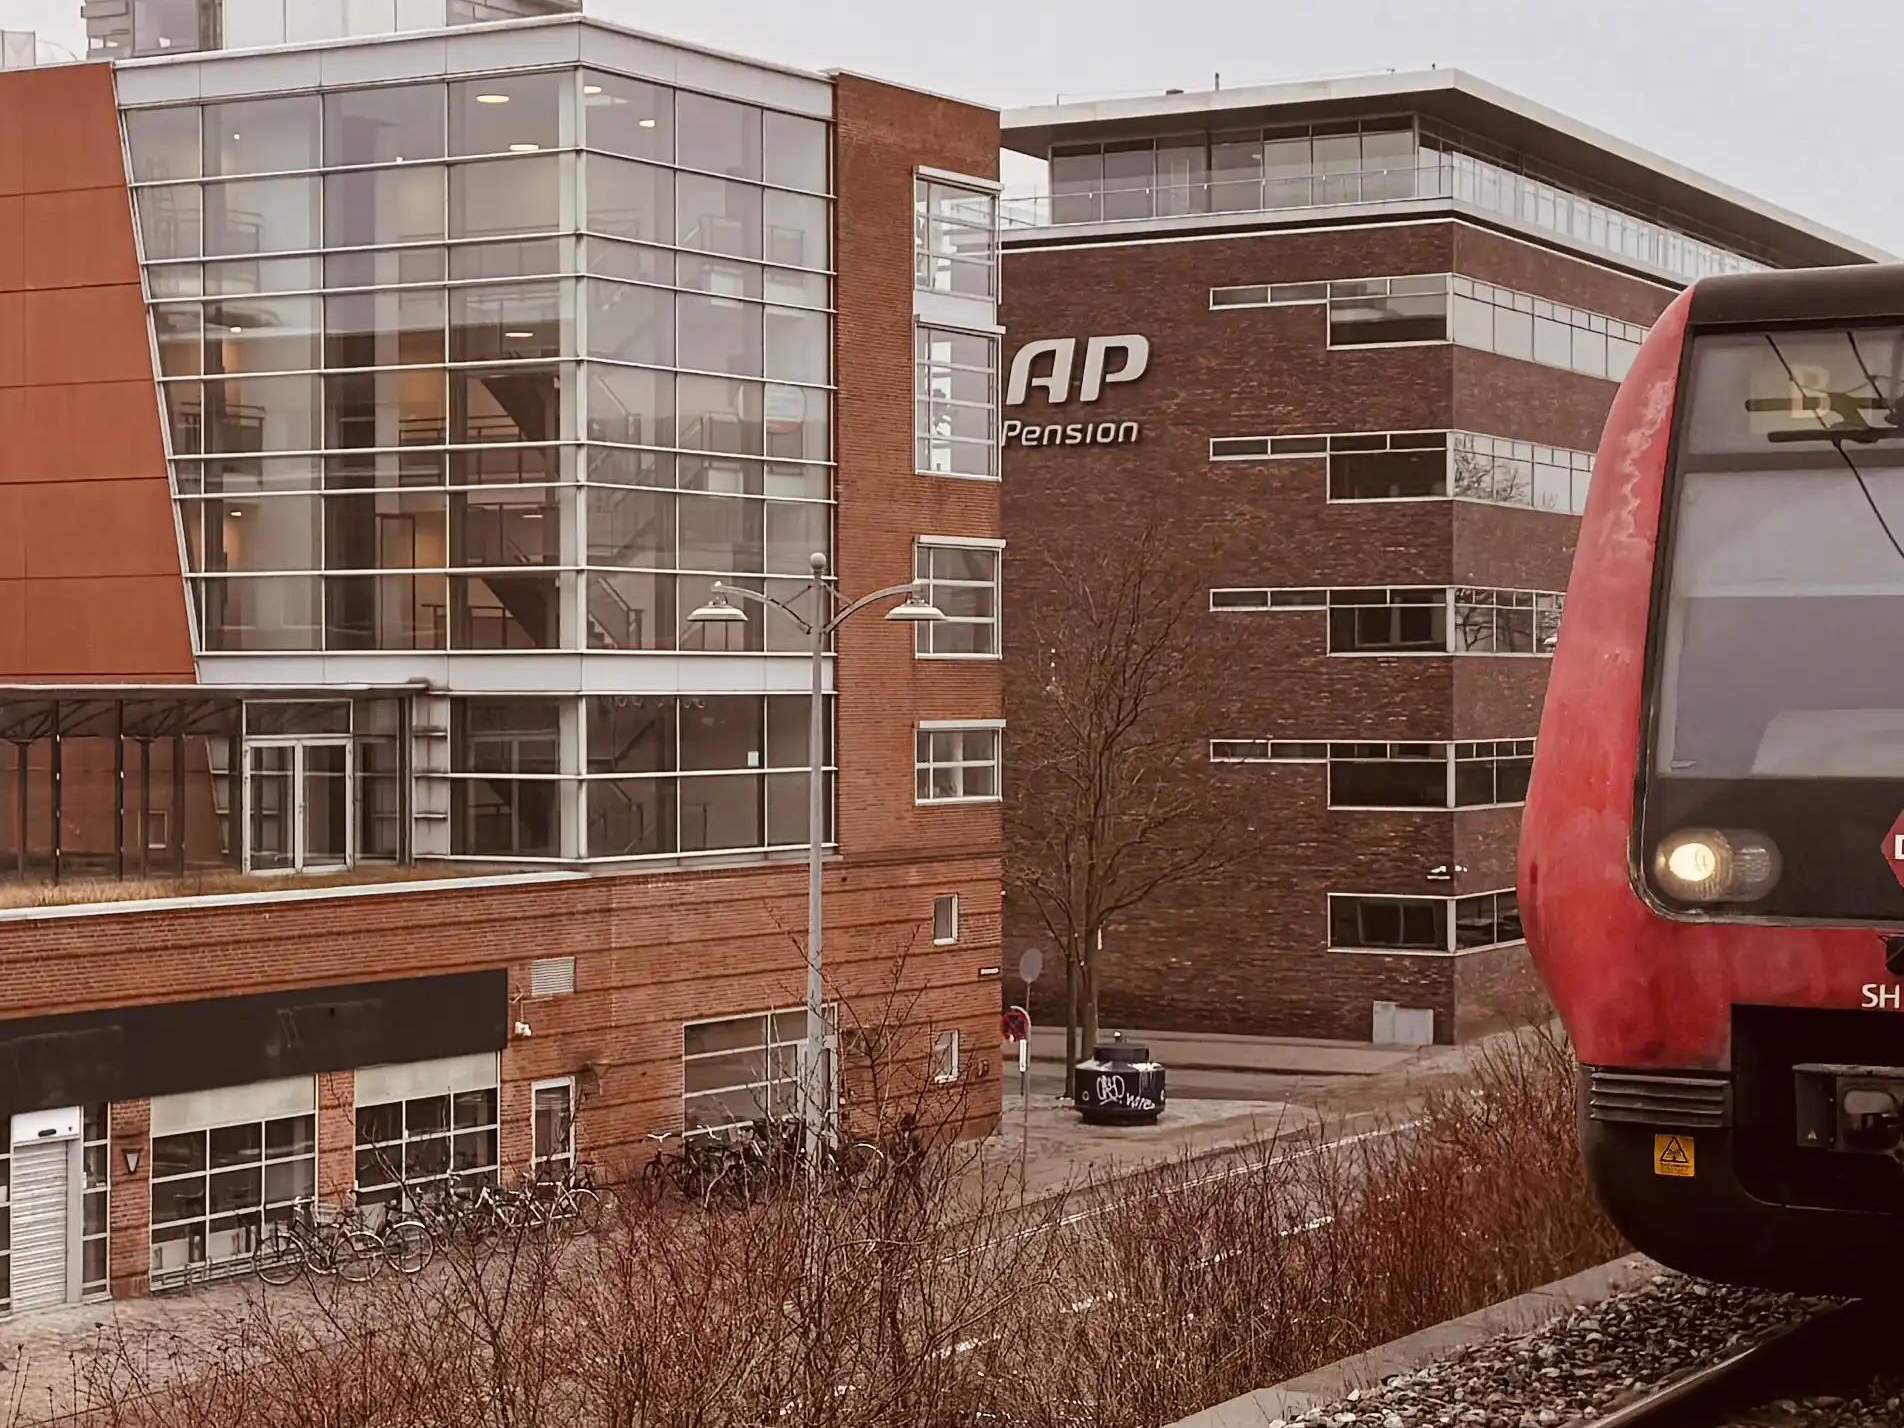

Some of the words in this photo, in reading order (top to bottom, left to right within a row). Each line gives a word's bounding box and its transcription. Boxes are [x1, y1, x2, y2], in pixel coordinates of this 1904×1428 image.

[1005, 334, 1149, 406] AP
[1790, 364, 1831, 420] B
[1001, 420, 1139, 447] Pension
[1861, 983, 1900, 1009] SH
